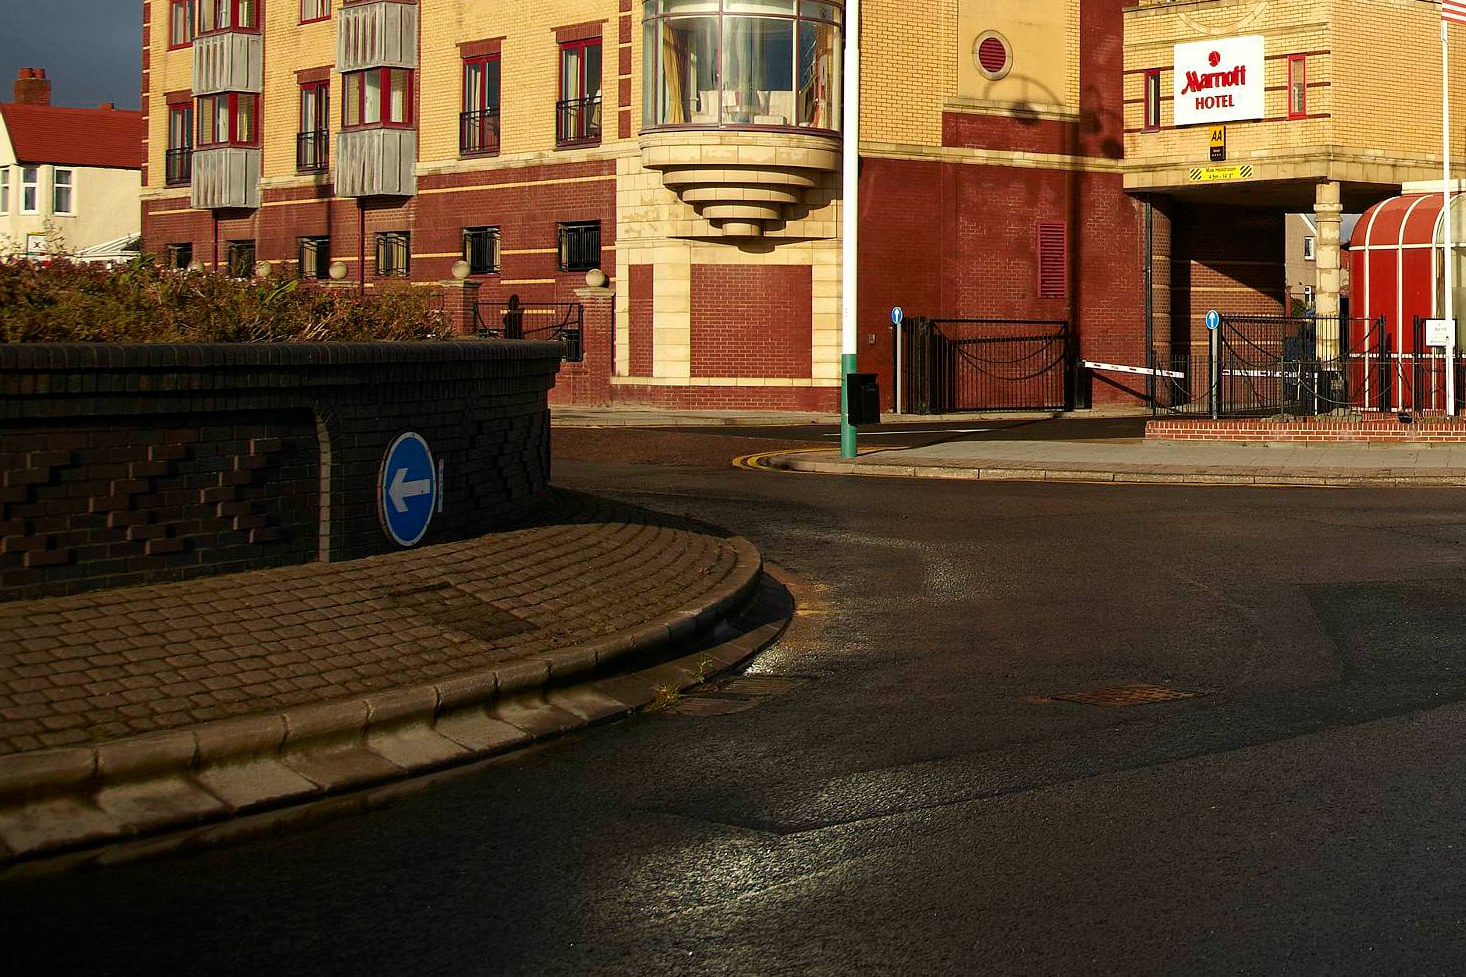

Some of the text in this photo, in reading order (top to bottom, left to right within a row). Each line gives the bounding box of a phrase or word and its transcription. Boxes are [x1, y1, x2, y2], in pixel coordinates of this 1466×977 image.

[1181, 65, 1247, 95] Marriott
[1195, 94, 1235, 110] HOTEL
[1211, 129, 1222, 141] AA
